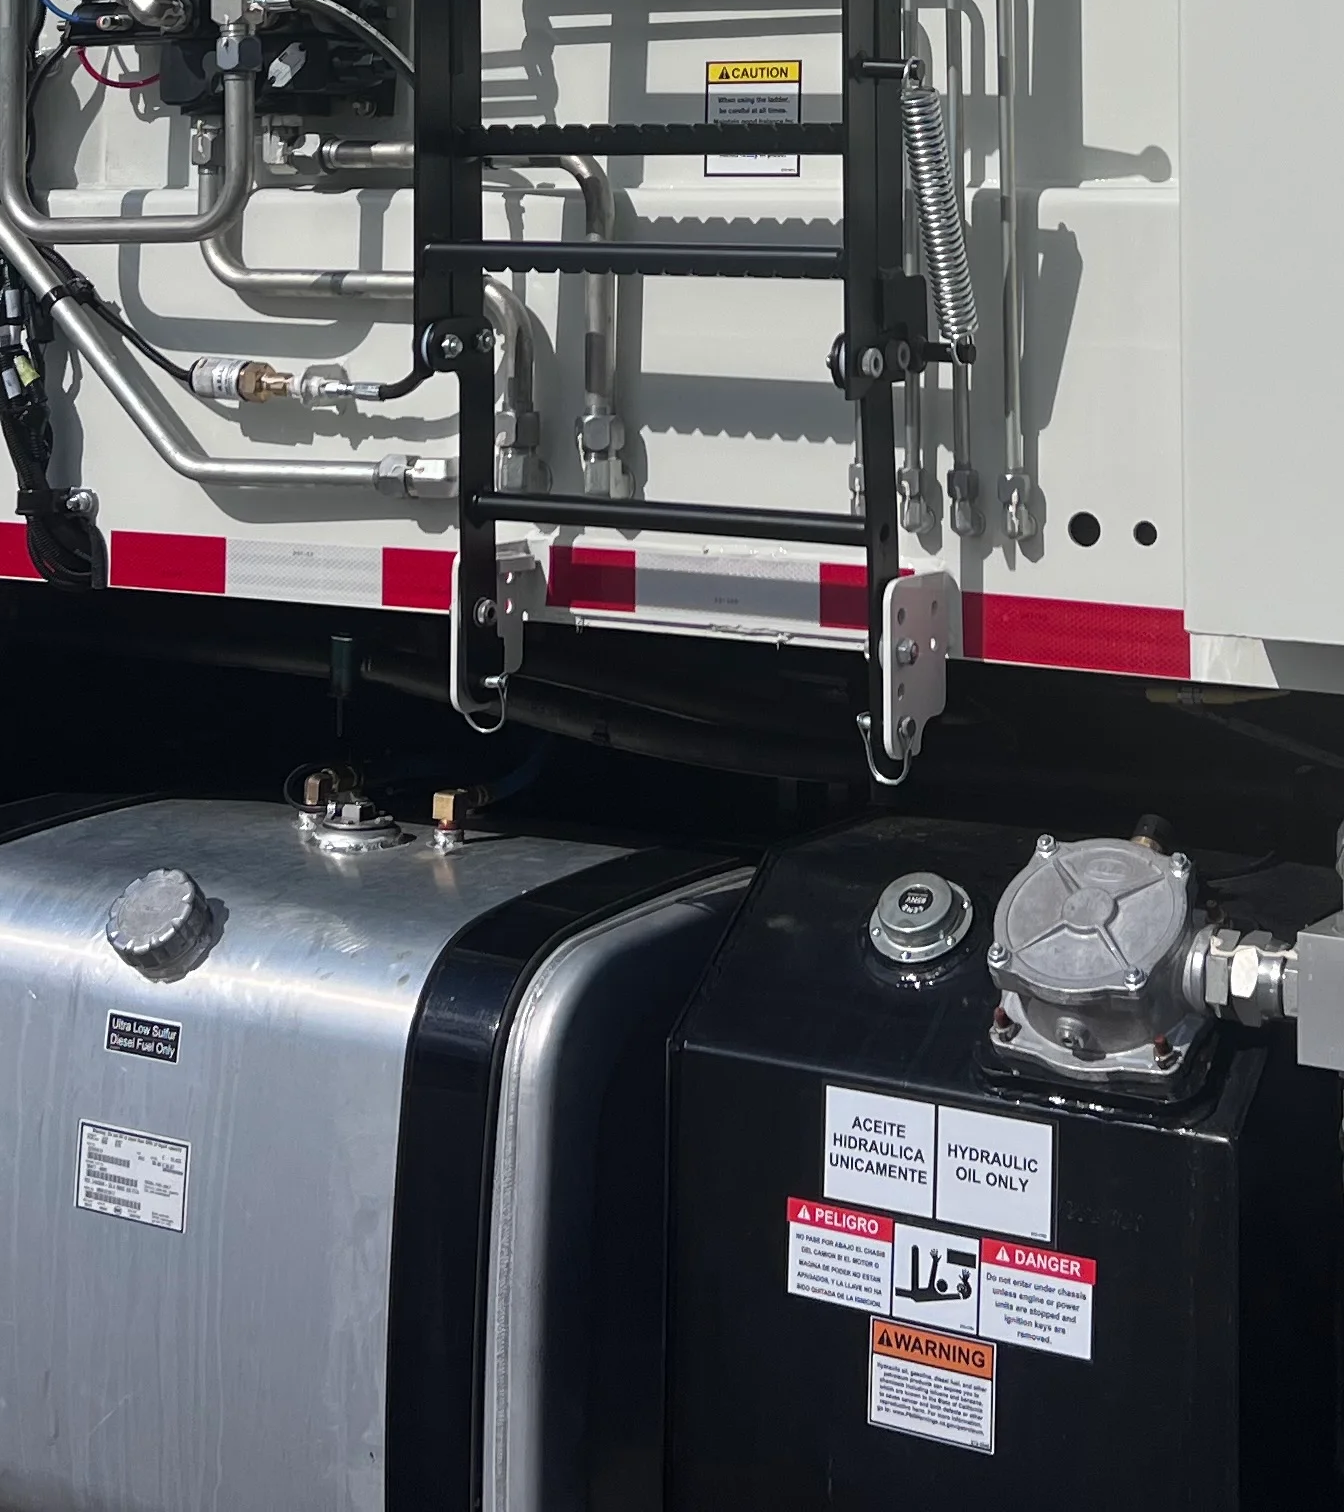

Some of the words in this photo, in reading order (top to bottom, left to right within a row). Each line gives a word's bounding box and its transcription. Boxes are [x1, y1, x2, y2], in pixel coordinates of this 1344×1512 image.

[732, 67, 789, 79] CAUTION
[112, 1017, 131, 1032] Ultra
[133, 1022, 151, 1035] Low
[152, 1025, 177, 1041] Sulfur
[110, 1032, 135, 1048] Diesel
[136, 1038, 155, 1052] Fuel
[156, 1042, 176, 1059] Only
[852, 1116, 906, 1138] ACEITE
[833, 1133, 925, 1164] HIDRAULICA
[947, 1143, 1038, 1173] HYDRAULIC
[829, 1152, 927, 1185] UNICAMENTE
[956, 1167, 981, 1184] OIL
[985, 1172, 1029, 1192] ONLY
[815, 1208, 879, 1234] PELIGRO
[1015, 1249, 1081, 1277] DANGER
[992, 1288, 1017, 1298] unless
[1019, 1293, 1044, 1304] engine
[1056, 1301, 1080, 1312] power
[1013, 1279, 1032, 1288] enter
[1034, 1283, 1056, 1293] under
[1057, 1288, 1087, 1301] chassis
[995, 1301, 1013, 1311] units
[1030, 1308, 1060, 1321] stopped
[1062, 1314, 1077, 1324] and
[1004, 1314, 1033, 1327] ignition
[1034, 1320, 1052, 1332] keys
[894, 1331, 985, 1368] WARNING
